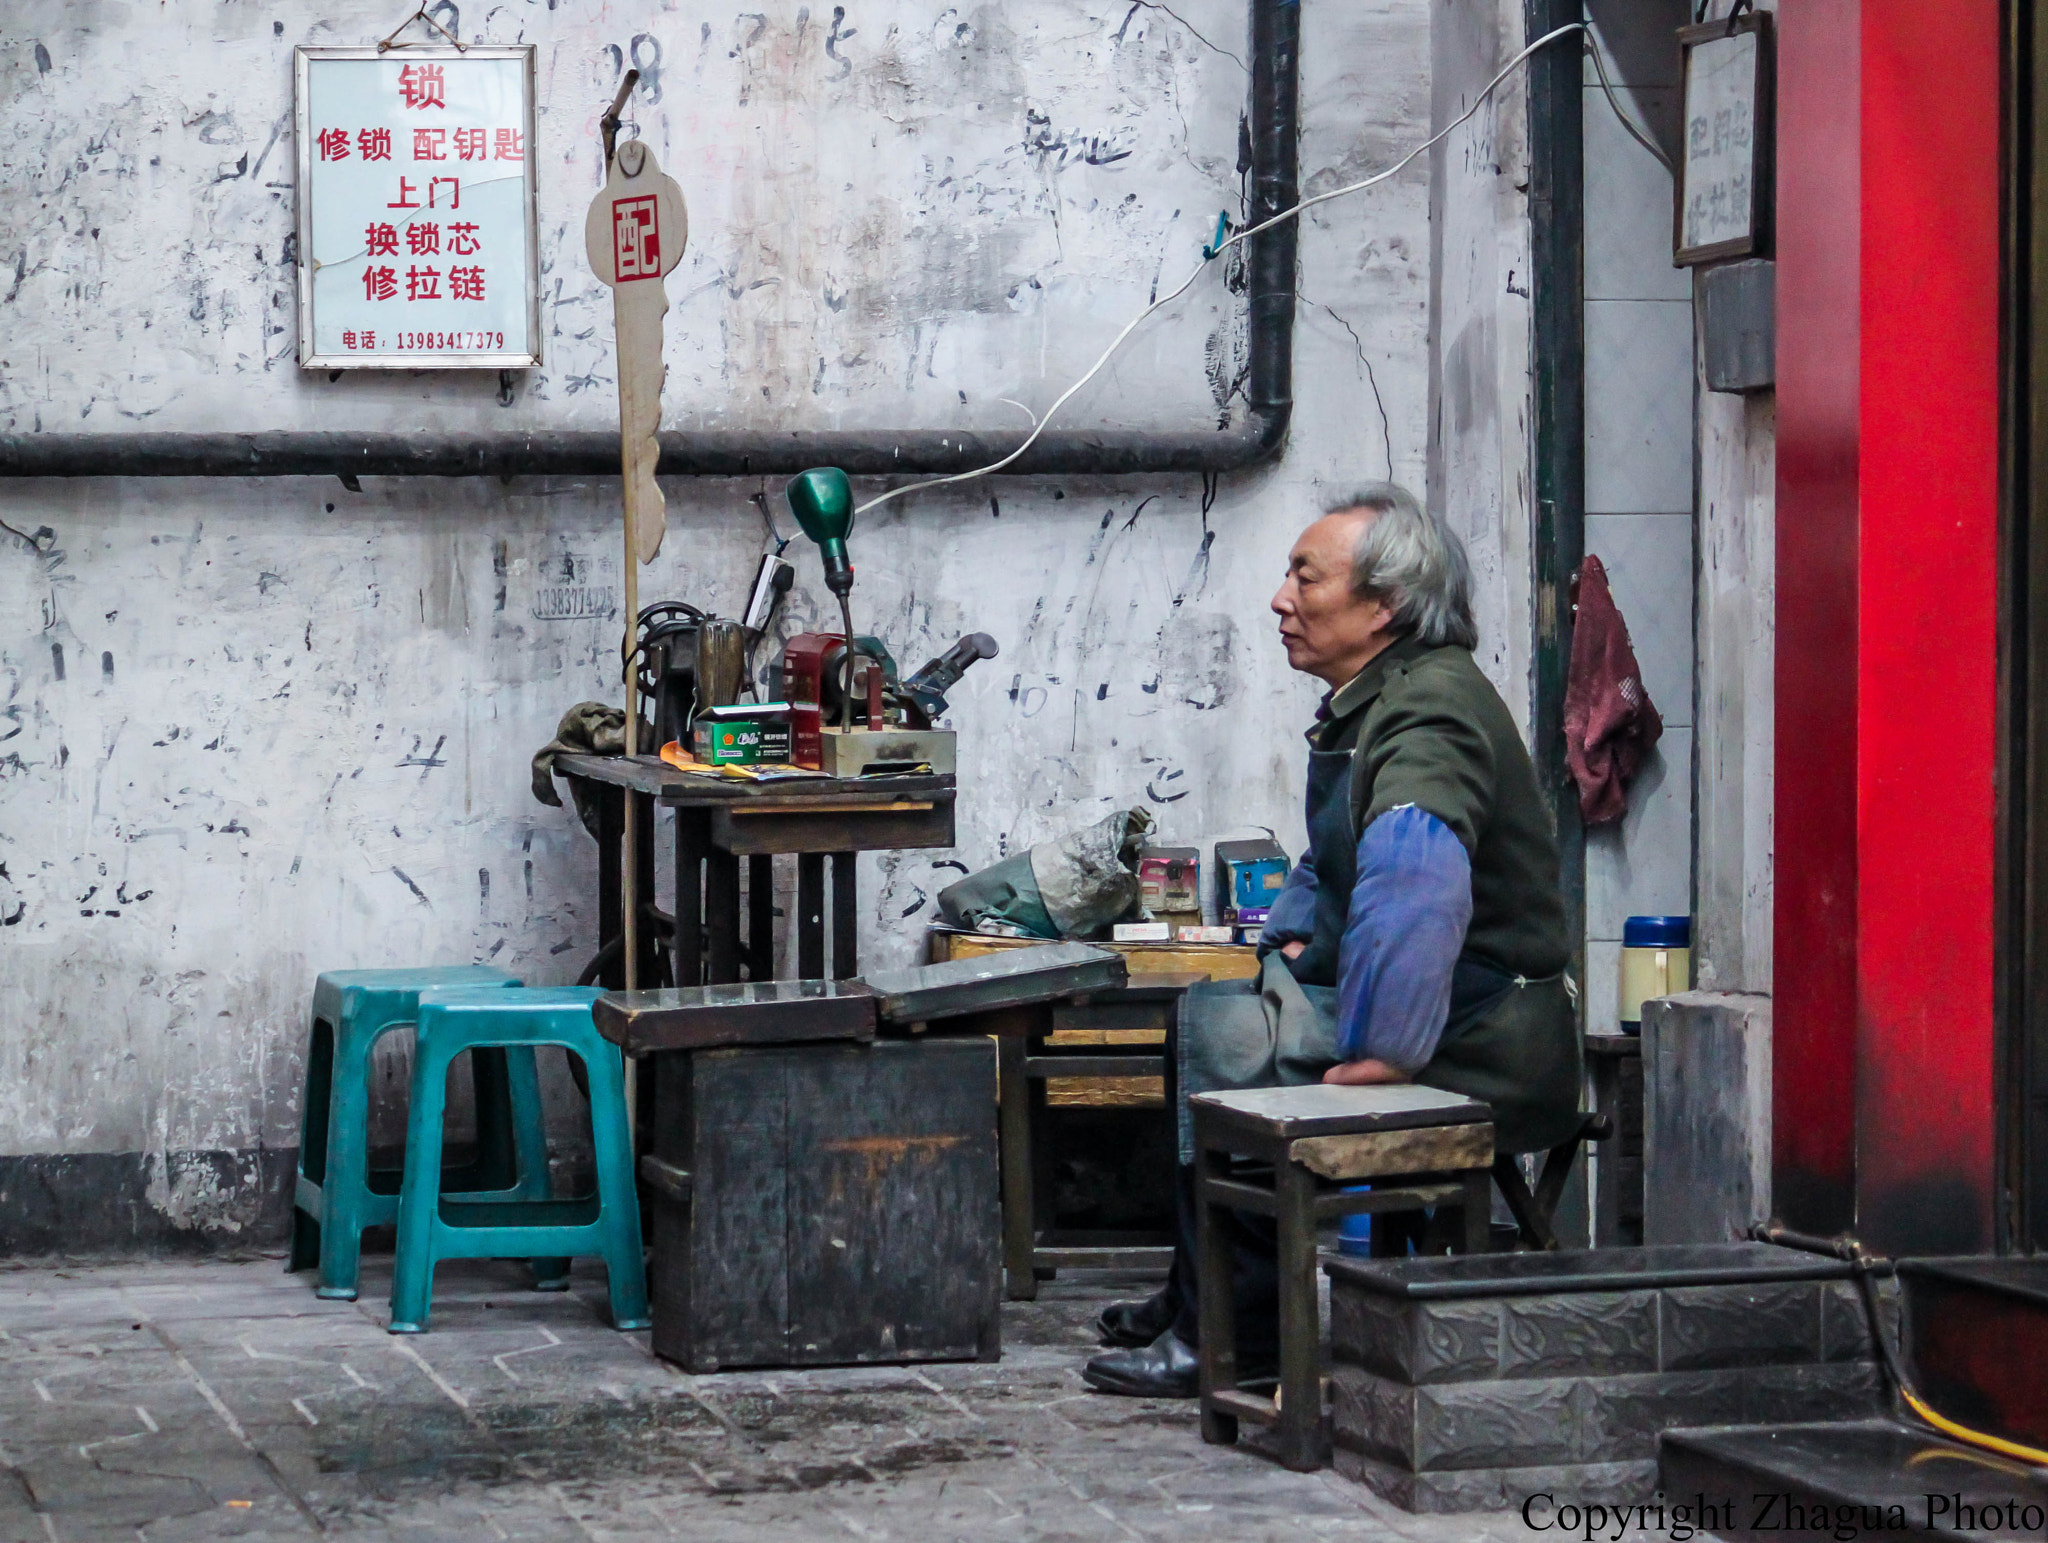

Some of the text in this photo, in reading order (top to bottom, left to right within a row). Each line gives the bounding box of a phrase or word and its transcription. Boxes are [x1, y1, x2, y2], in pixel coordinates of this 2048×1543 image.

[397, 63, 446, 111] 锁
[317, 127, 524, 162] 修锁 配钥匙
[386, 175, 460, 210] 上门
[364, 221, 482, 257] 换锁芯
[615, 198, 659, 277] 配
[361, 264, 486, 302] 修拉链
[397, 331, 504, 350] 13983417379
